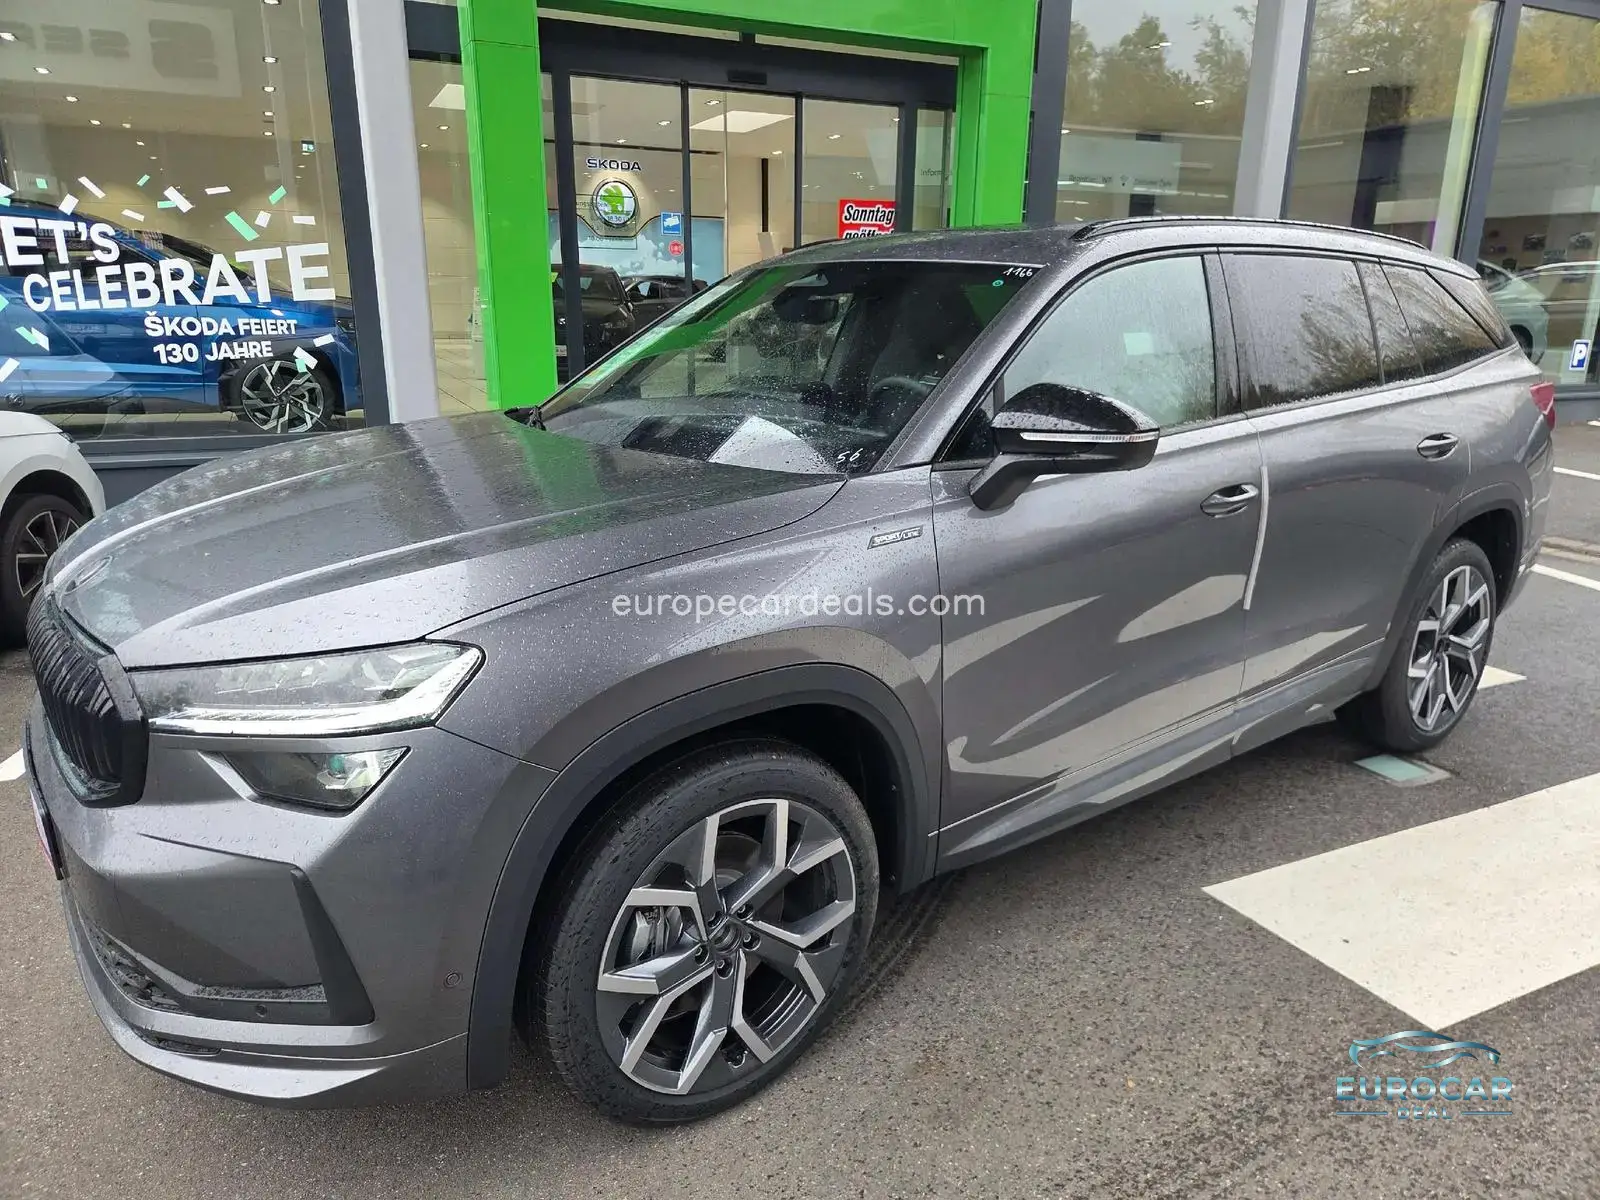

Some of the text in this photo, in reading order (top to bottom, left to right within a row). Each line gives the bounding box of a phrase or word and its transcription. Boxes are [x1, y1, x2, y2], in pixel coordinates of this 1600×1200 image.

[844, 204, 896, 226] Sonntag
[0, 215, 120, 264] ET'S
[23, 243, 336, 312] CELEBRATE
[144, 311, 298, 337] ŠKODA FEIERT
[153, 341, 274, 364] 130 JAHRE
[1572, 343, 1587, 366] P
